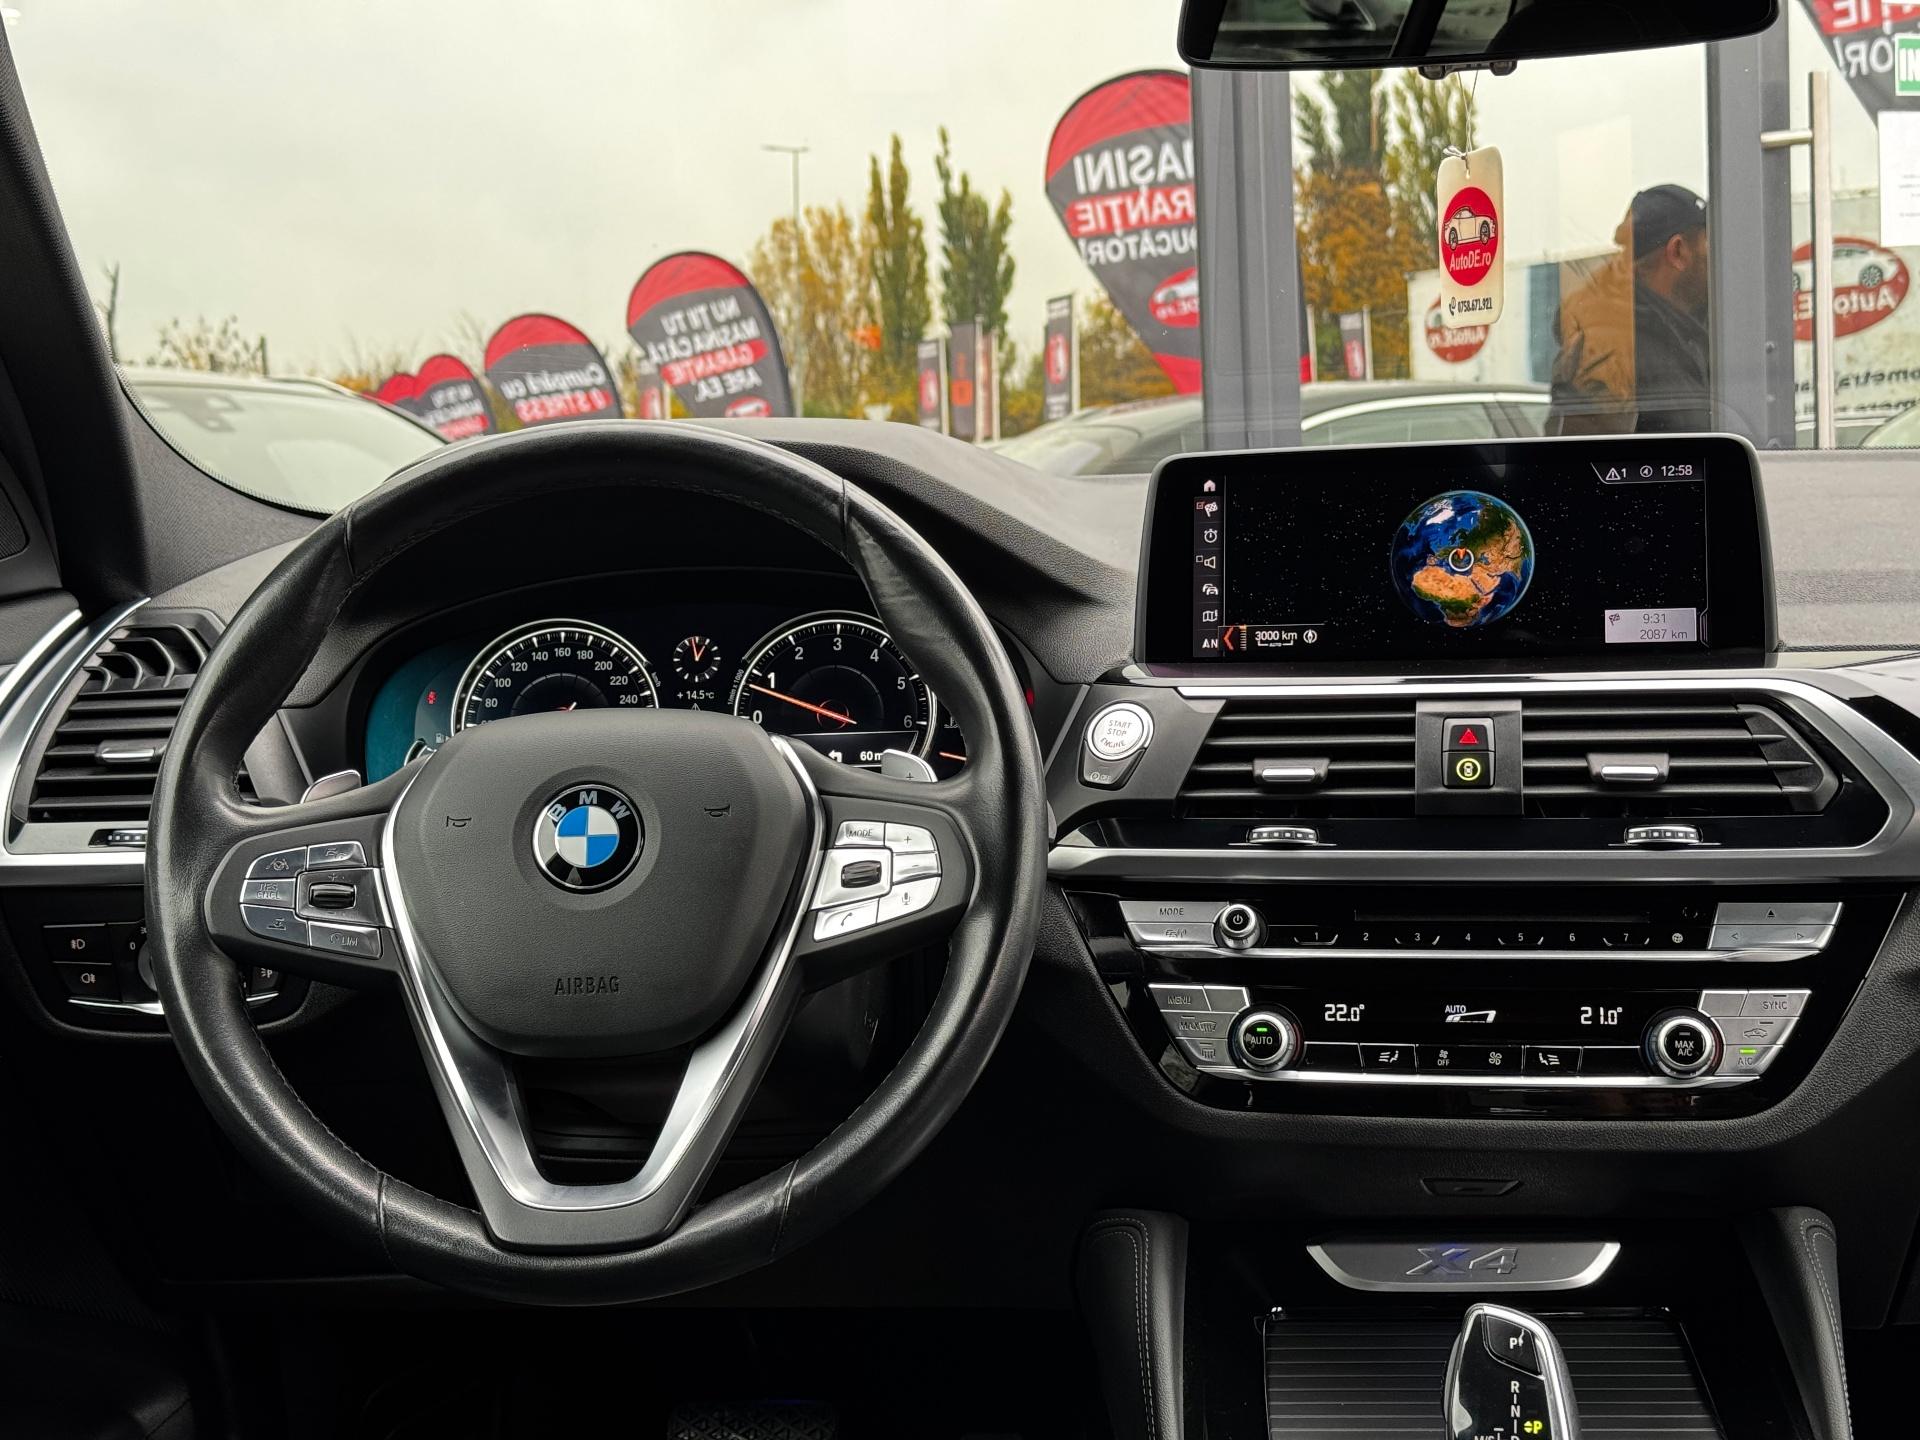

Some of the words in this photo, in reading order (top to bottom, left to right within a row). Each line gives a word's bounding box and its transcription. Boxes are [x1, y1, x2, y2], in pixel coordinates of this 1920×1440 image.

[1449, 249, 1492, 272] AutoDE.ro
[1622, 468, 1626, 478] 1
[1661, 465, 1693, 476] 12:58
[1643, 614, 1666, 624] 9:31
[1255, 631, 1280, 640] 3000
[1282, 631, 1297, 640] km
[1640, 630, 1667, 640] 2087
[1672, 630, 1688, 640] km
[833, 637, 842, 650] 3
[1202, 638, 1218, 648] AN
[532, 651, 549, 661] 140
[554, 648, 571, 657] 160
[577, 650, 594, 660] 180
[795, 647, 804, 660] 2
[870, 650, 879, 662] 4
[511, 662, 528, 672] 120
[594, 661, 613, 671] 200
[494, 678, 511, 688] 100
[610, 676, 628, 686] 220
[767, 672, 776, 689] 1
[897, 677, 906, 690] 5
[485, 698, 498, 708] 80
[619, 695, 638, 705] 240
[753, 710, 763, 724] 0
[904, 715, 913, 728] 6
[1108, 720, 1132, 729] START
[1107, 728, 1127, 737] STOP
[860, 751, 873, 761] 60
[547, 790, 634, 823] BMW
[849, 829, 873, 838] MODE
[259, 883, 278, 891] RES
[1159, 908, 1184, 916] MODE
[1314, 932, 1319, 941] 1
[1363, 932, 1369, 941] 2
[1414, 932, 1421, 941] 3
[1465, 933, 1471, 941] 4
[1518, 933, 1524, 942] 5
[1569, 933, 1575, 942] 6
[1623, 933, 1629, 942] 7
[554, 976, 620, 996] AIRBAG
[1167, 996, 1191, 1005] MENU
[1762, 1001, 1788, 1010] SYNC
[1445, 1004, 1466, 1014] AUTO
[1178, 1021, 1200, 1031] MAX
[1250, 1036, 1273, 1045] AUTO
[1674, 1040, 1694, 1049] MAX
[1677, 1048, 1693, 1056] A/C
[1437, 1059, 1450, 1067] OFF
[1737, 1057, 1753, 1065] A/C
[1405, 1247, 1519, 1275] X4
[1509, 1337, 1518, 1349] P
[1510, 1381, 1520, 1393] R
[1510, 1405, 1520, 1418] N
[1533, 1421, 1542, 1434] P
